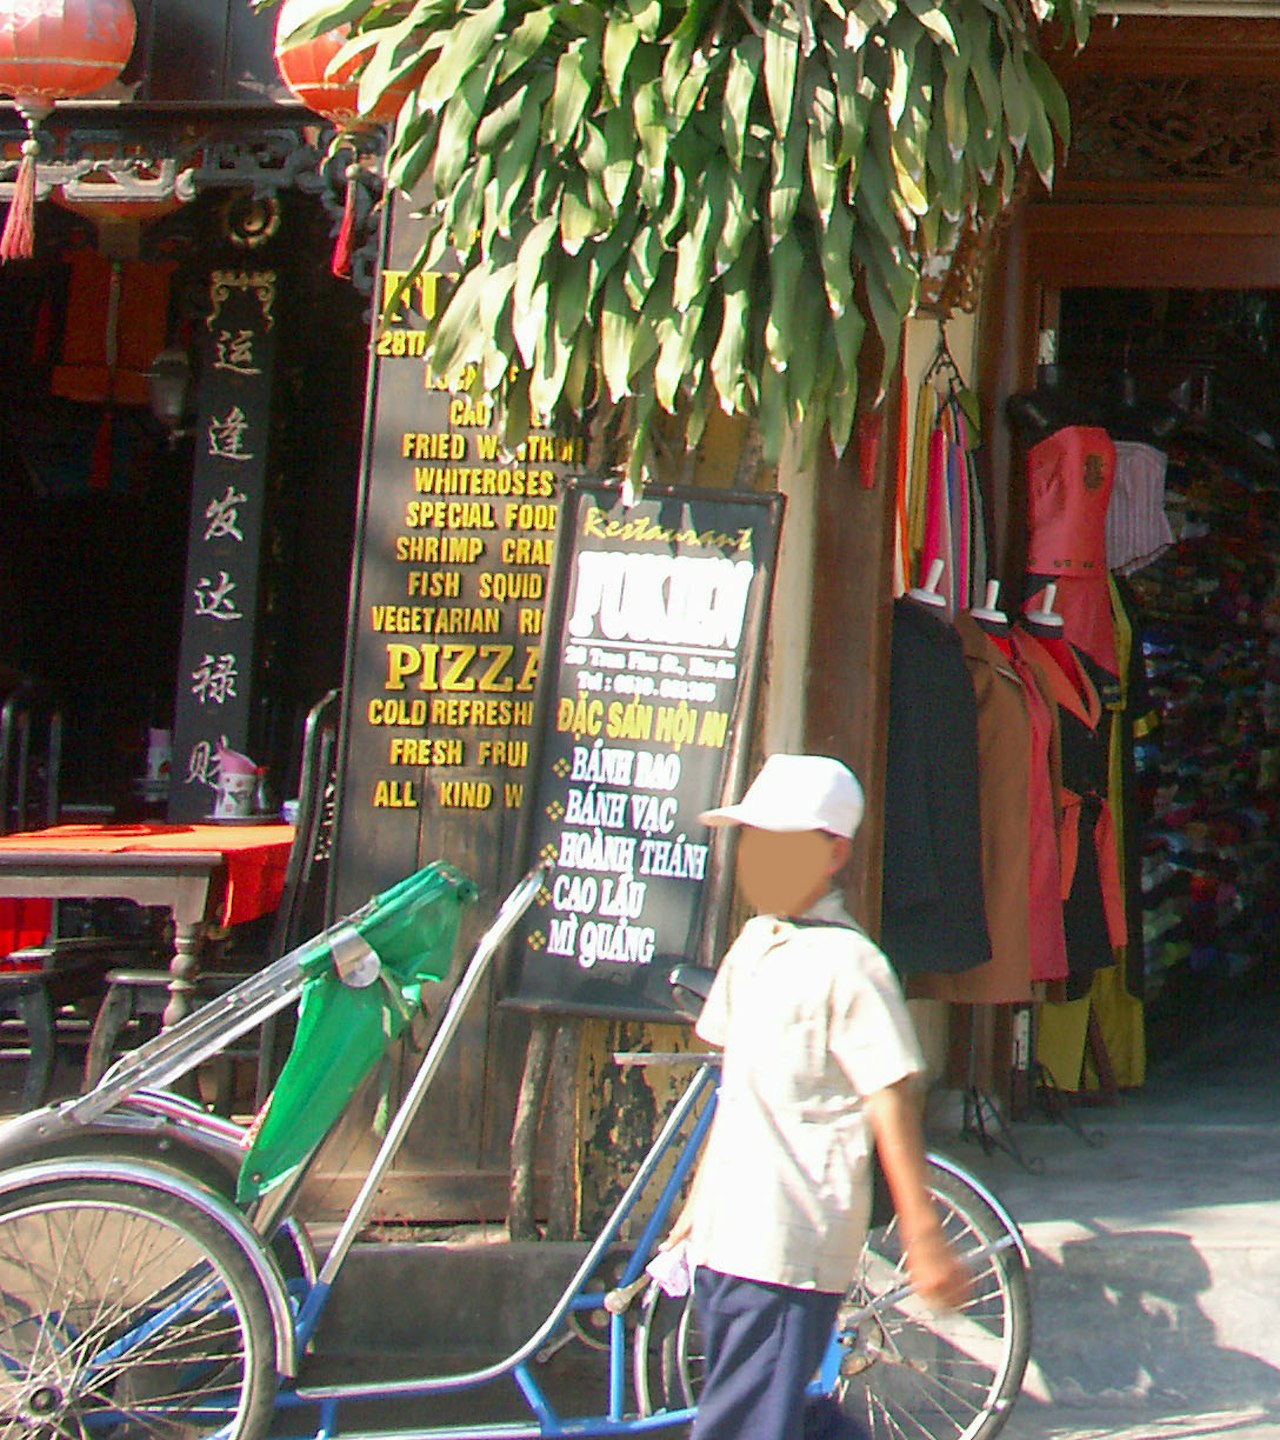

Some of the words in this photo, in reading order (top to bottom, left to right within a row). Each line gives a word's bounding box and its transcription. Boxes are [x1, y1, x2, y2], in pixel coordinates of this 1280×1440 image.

[402, 432, 466, 461] FRIED
[413, 466, 555, 498] WHITEROSES
[404, 500, 496, 530] SPECIAL
[583, 506, 754, 552] Restaurant
[395, 536, 484, 564] SHRIMP
[407, 570, 461, 598] FISH
[478, 572, 543, 603] SQUID
[371, 606, 500, 634] VEGETARIAN
[384, 643, 541, 693] PIZZA
[367, 698, 427, 727] COLD
[556, 690, 605, 742] ĐẶC
[697, 709, 729, 749] AN
[389, 739, 464, 767] FRESH
[569, 737, 635, 788] BÁNH
[373, 780, 418, 809] ALL
[439, 781, 493, 810] KIND
[563, 783, 629, 830] BÁNH
[630, 793, 678, 838] VẠC
[638, 833, 710, 881] THÁNH
[551, 873, 598, 915] CAO
[546, 912, 579, 956] MÌ
